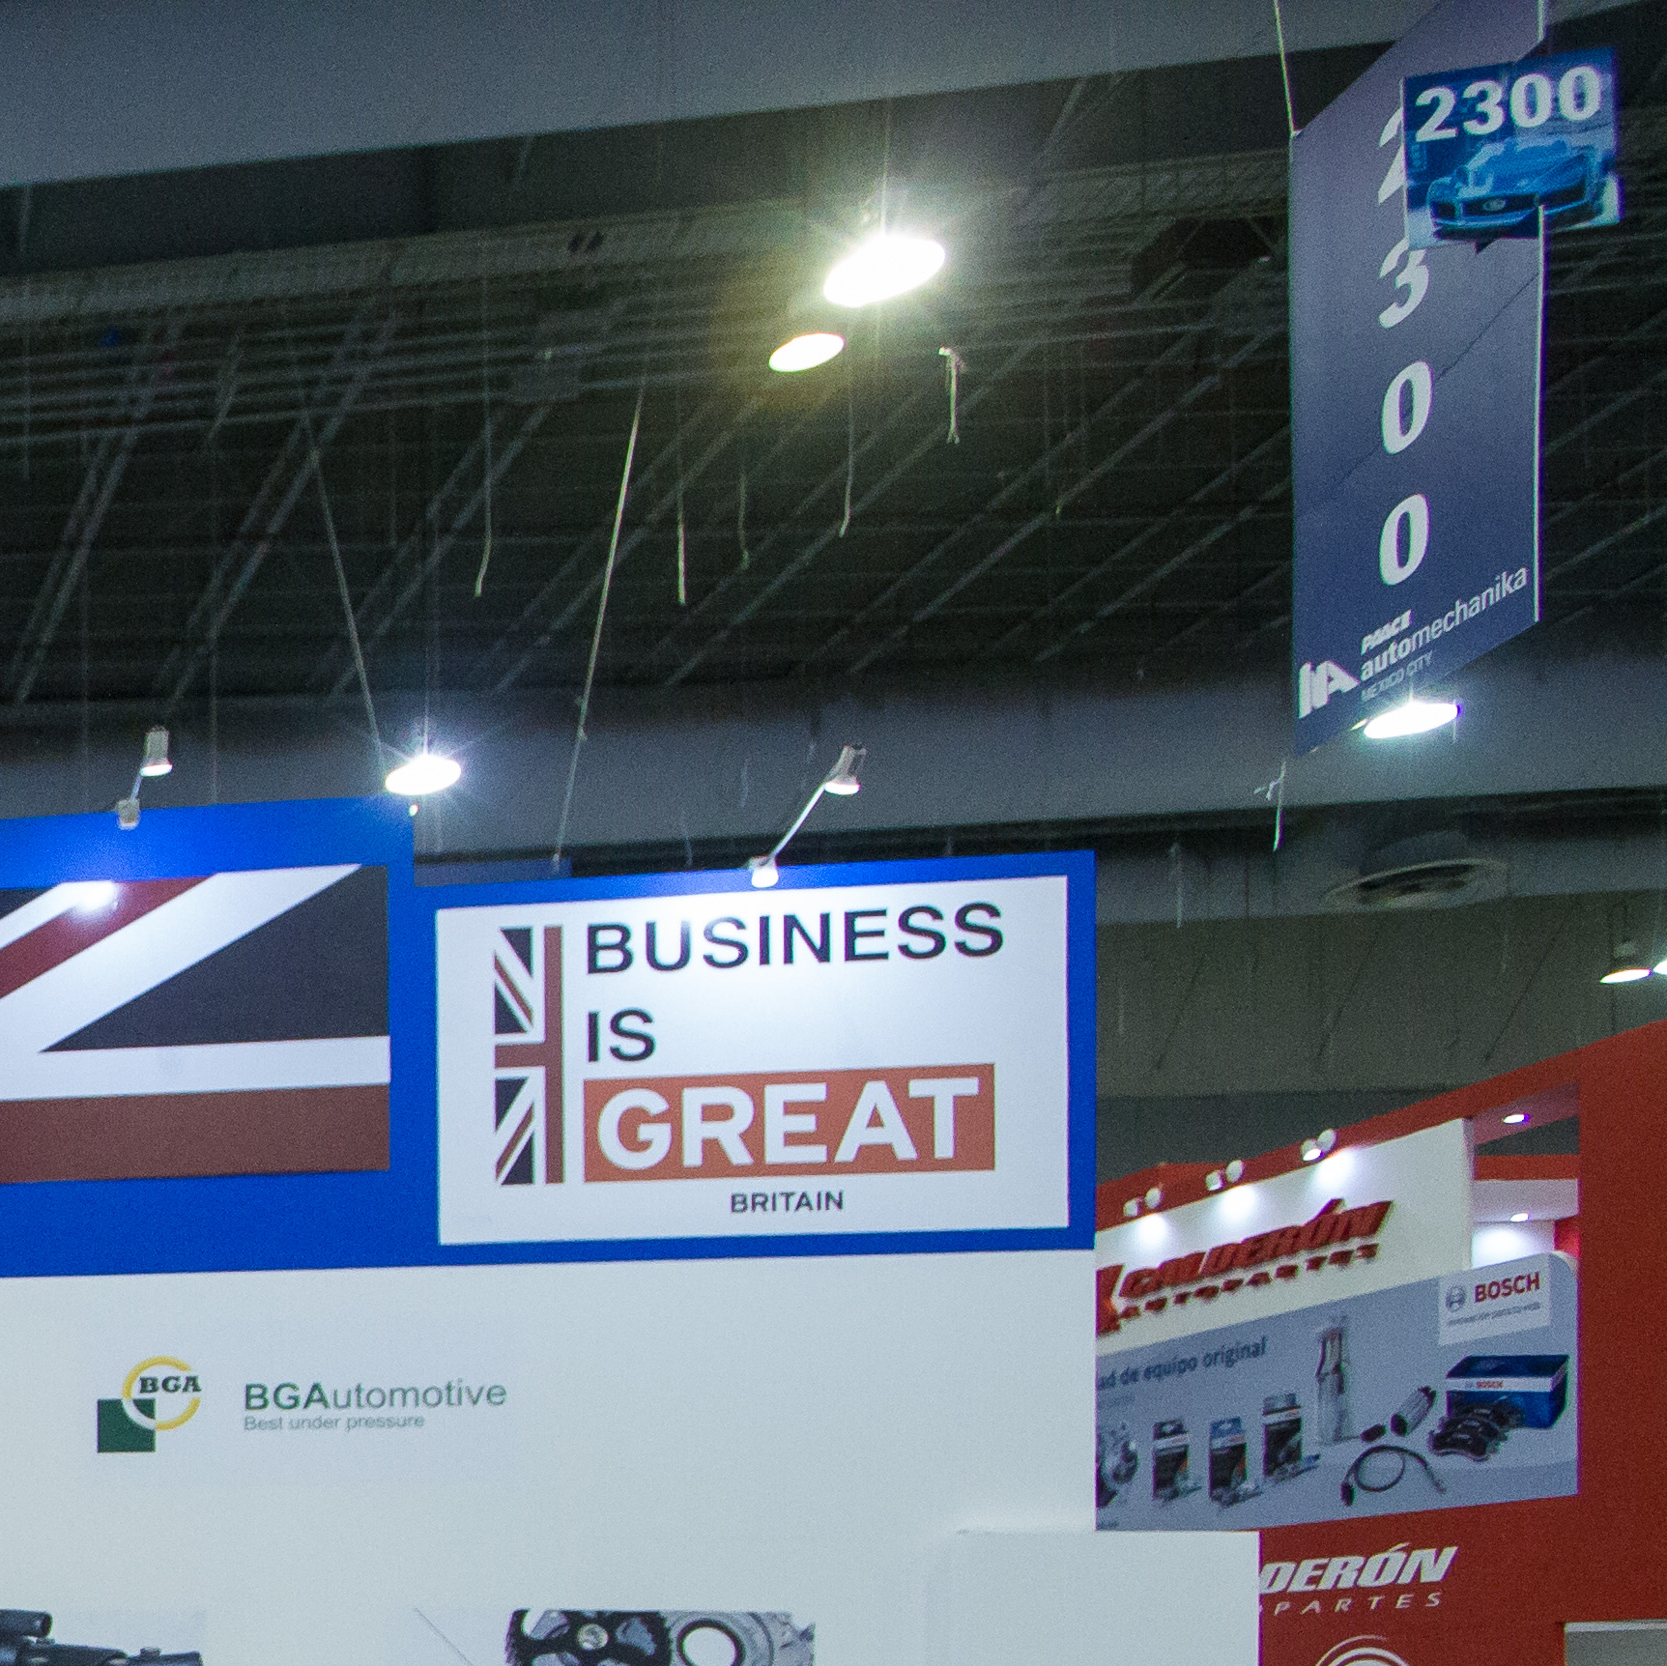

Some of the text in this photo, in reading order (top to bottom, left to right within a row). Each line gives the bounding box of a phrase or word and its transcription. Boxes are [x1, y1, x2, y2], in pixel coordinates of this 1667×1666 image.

[1415, 66, 1602, 142] 2300
[1361, 566, 1530, 683] automechanika
[587, 902, 1004, 974] BUSINESS
[587, 1008, 655, 1062] IS
[598, 1077, 980, 1170] GREAT
[730, 1190, 845, 1214] BRITAIN
[1474, 1271, 1540, 1303] BOSCH
[1202, 1335, 1267, 1368] original
[139, 1375, 202, 1394] BGA
[244, 1378, 507, 1411] BGAutomotive
[244, 1414, 425, 1432] Best under pressure
